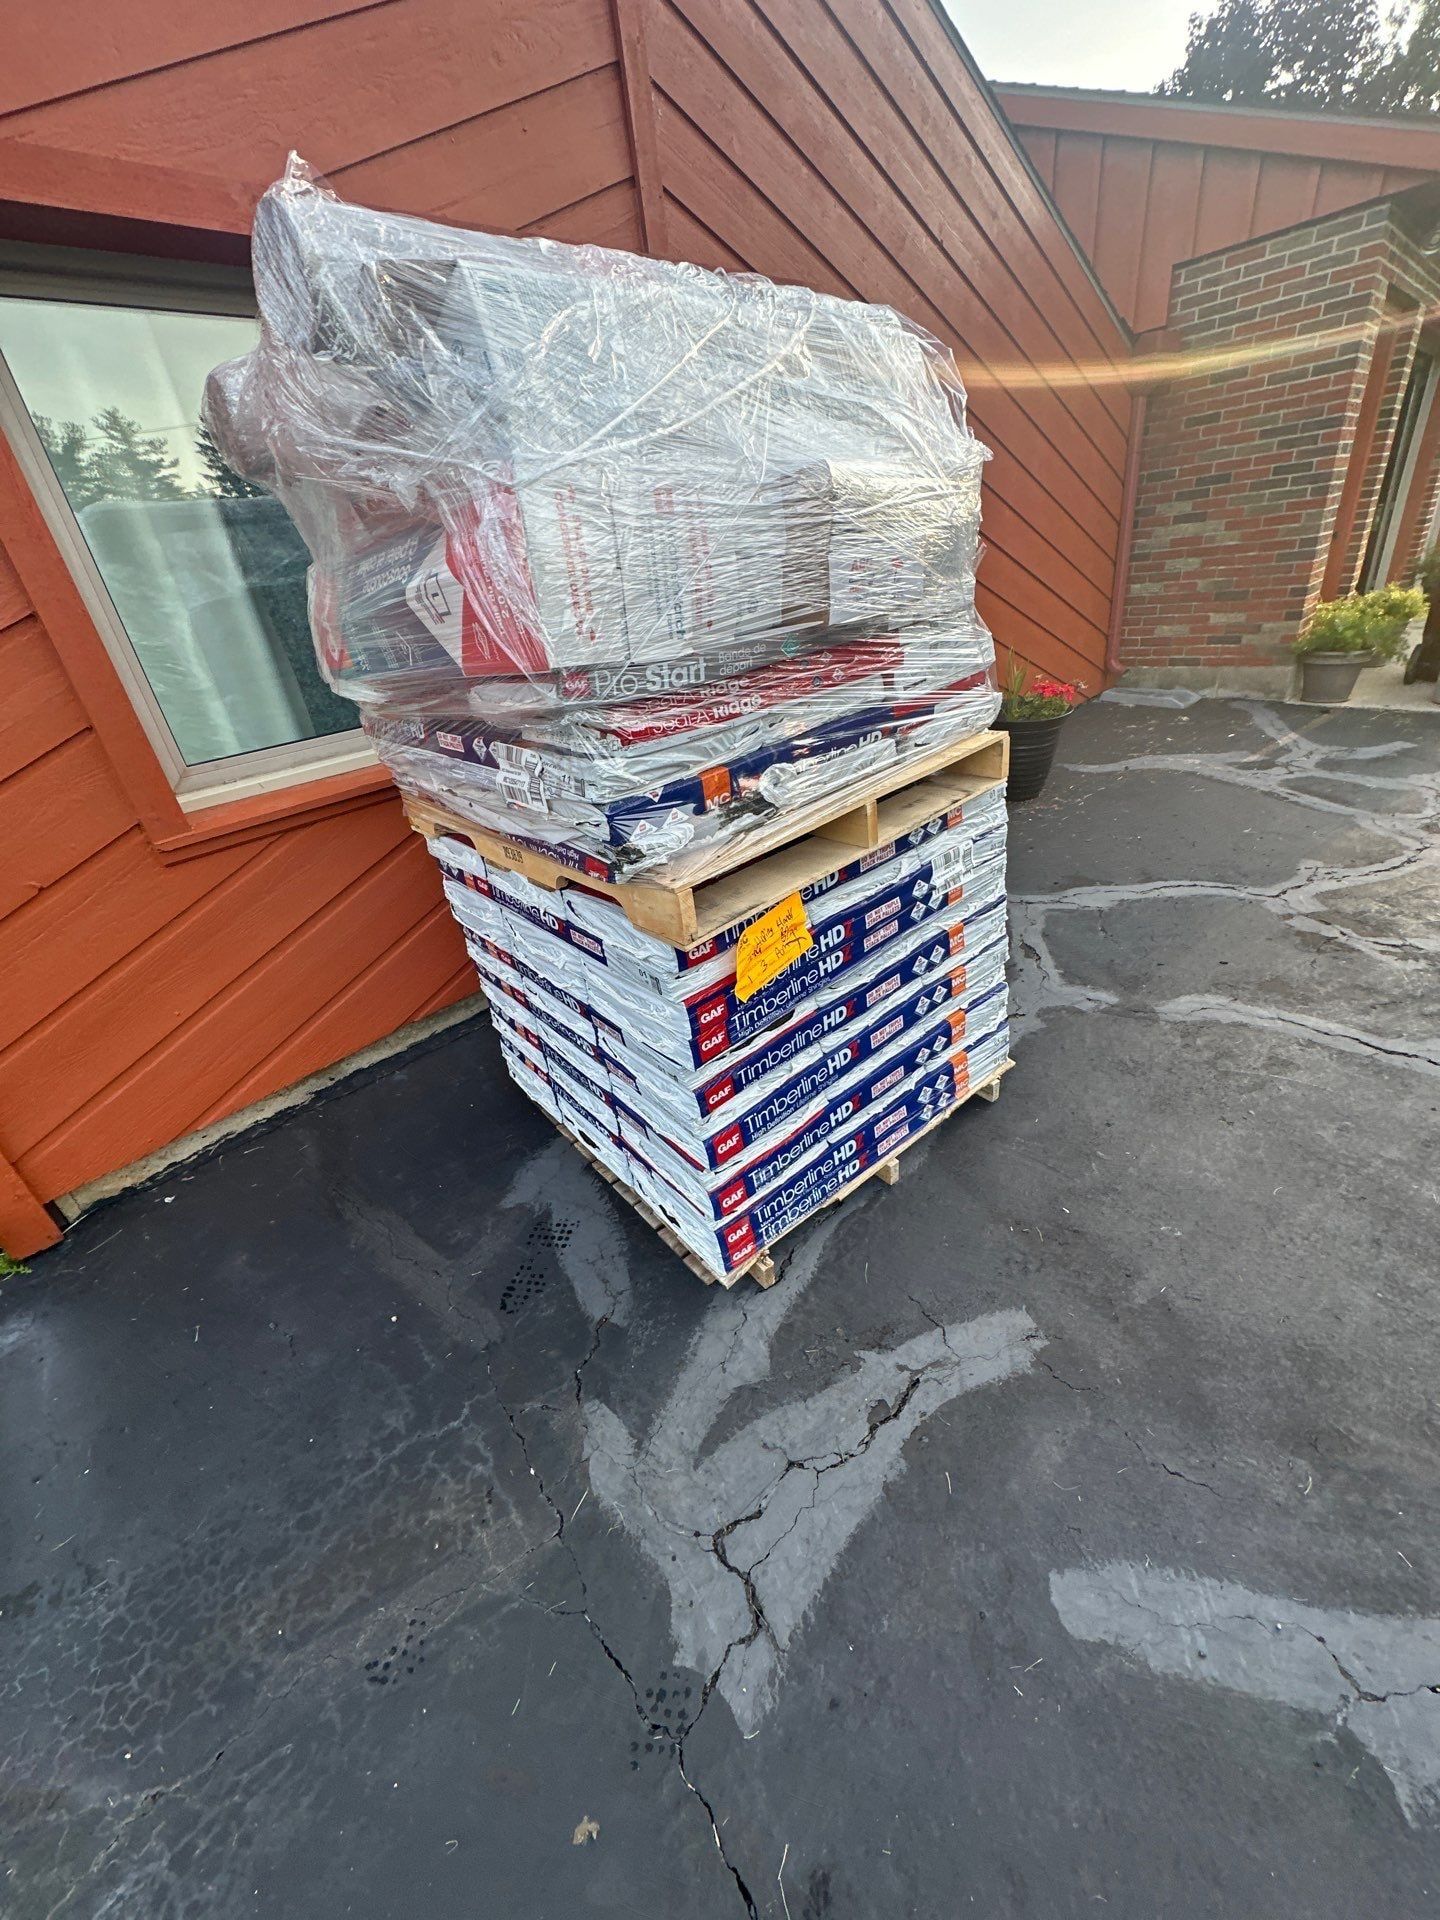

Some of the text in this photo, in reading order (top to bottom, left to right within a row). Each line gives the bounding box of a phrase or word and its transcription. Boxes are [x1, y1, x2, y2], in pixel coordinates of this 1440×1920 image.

[688, 942, 713, 959] GAF
[700, 1003, 725, 1024] GAF
[701, 1031, 725, 1052] GAF
[709, 1084, 732, 1105] GAF
[717, 1132, 740, 1154] GAF
[722, 1187, 744, 1208] GAF
[727, 1224, 749, 1243] GAF
[733, 1243, 754, 1261] GAF
